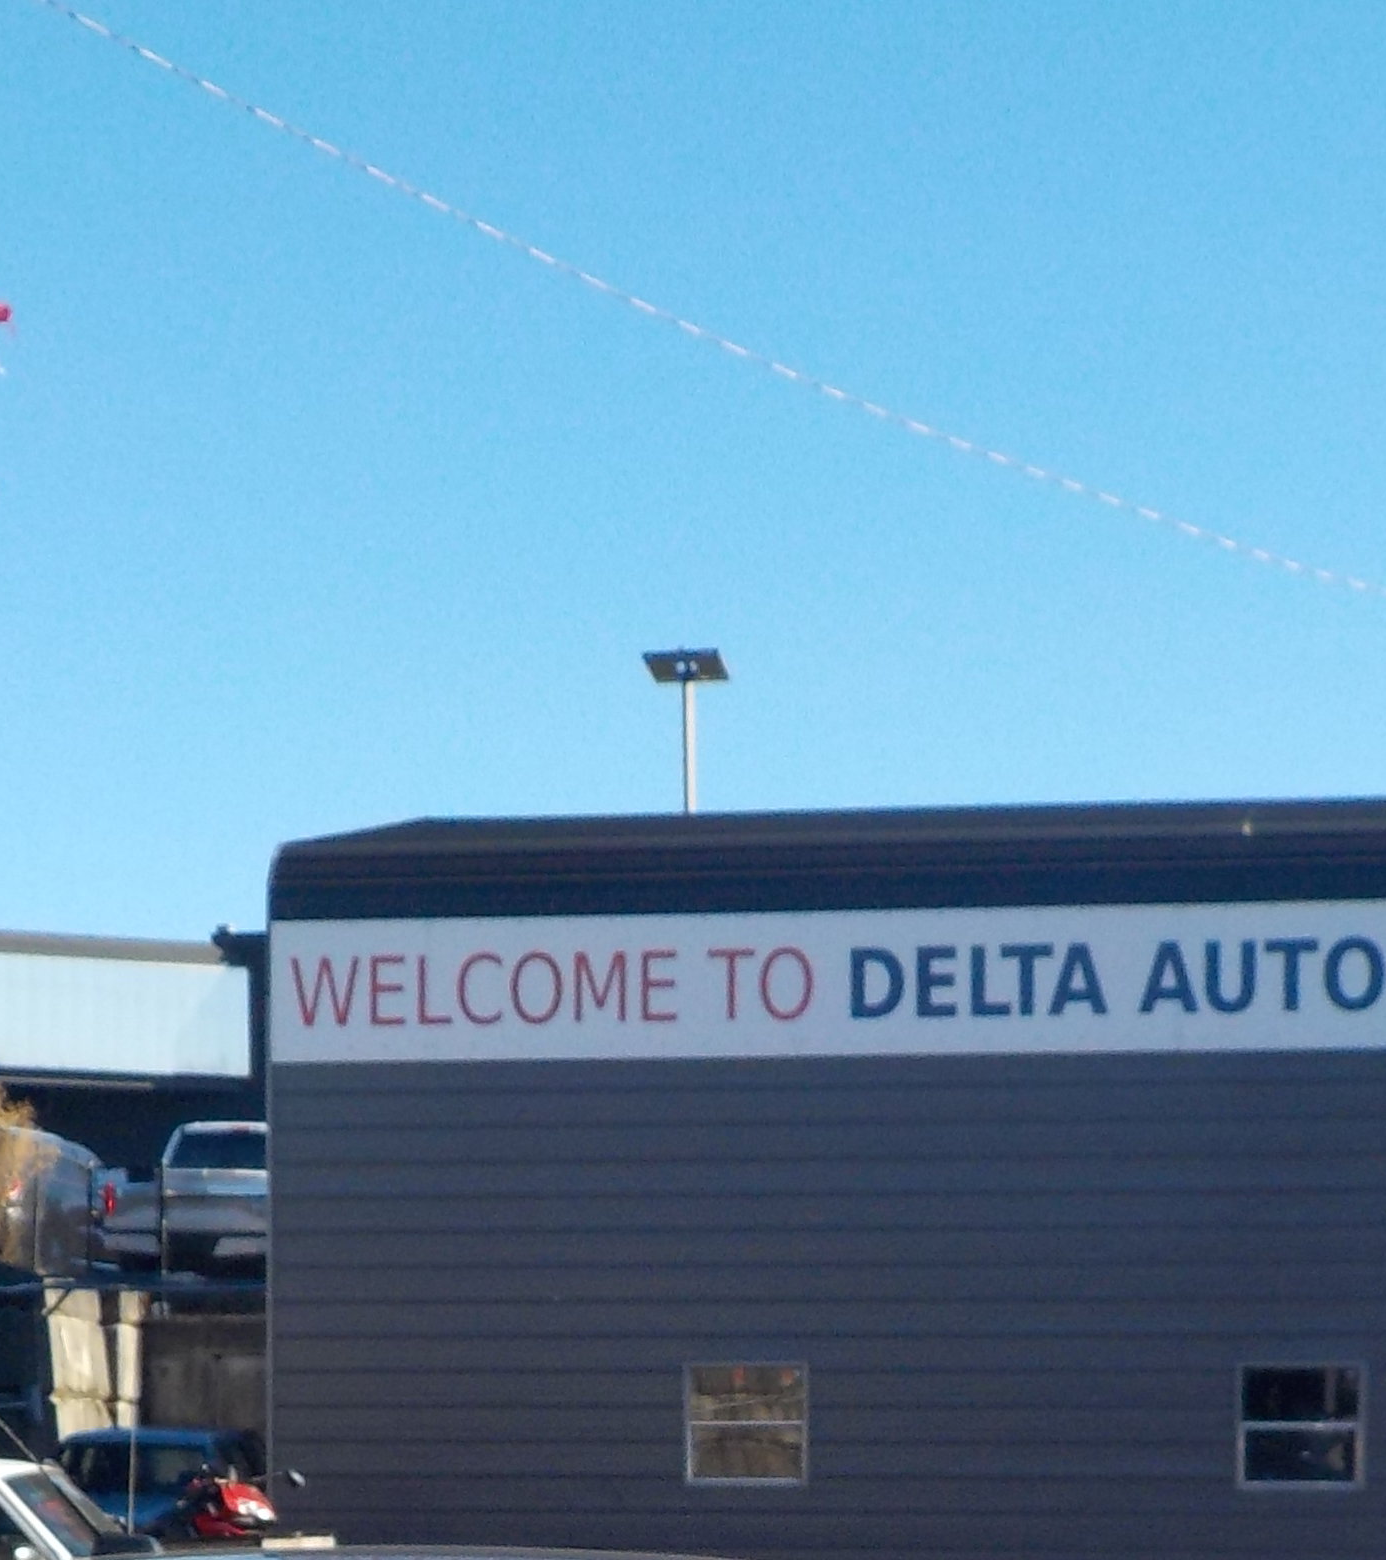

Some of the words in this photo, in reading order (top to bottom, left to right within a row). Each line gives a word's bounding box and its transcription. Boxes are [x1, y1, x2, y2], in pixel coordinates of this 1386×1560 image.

[289, 950, 678, 1027] WELCOME
[708, 946, 815, 1023] TO
[848, 942, 1108, 1018] DELTA
[1138, 935, 1386, 1013] AUTO
